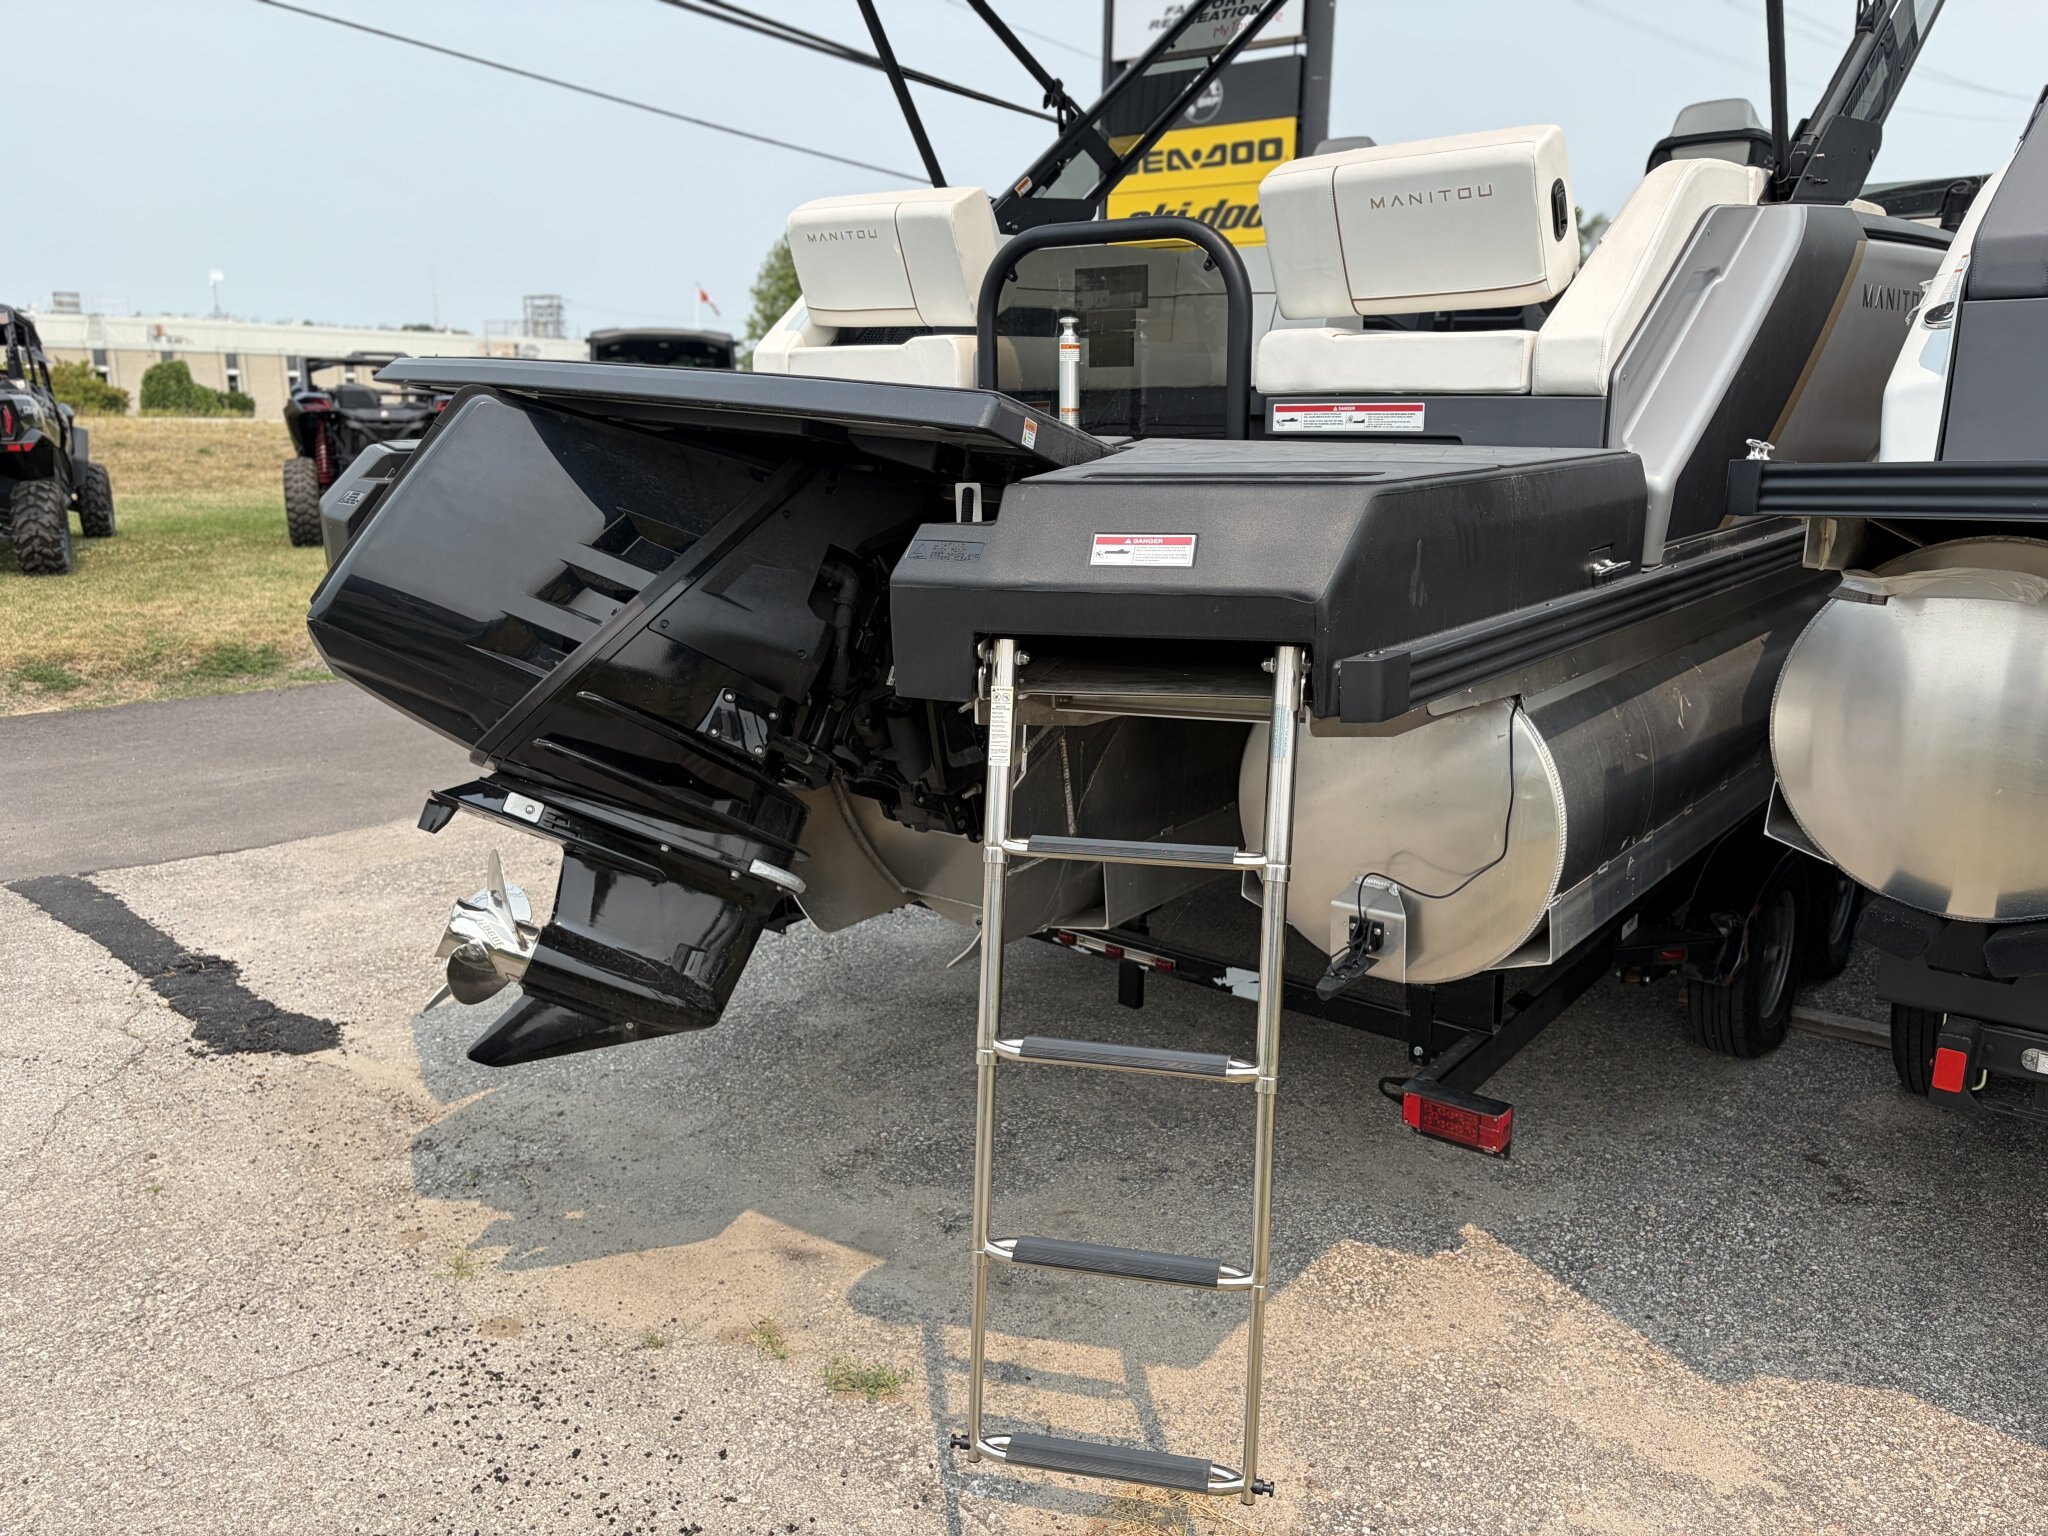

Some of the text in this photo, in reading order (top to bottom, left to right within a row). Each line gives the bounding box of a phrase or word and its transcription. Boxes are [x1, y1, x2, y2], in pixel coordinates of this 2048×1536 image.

[1370, 184, 1493, 210] MANITOU
[806, 229, 878, 243] MANITOU
[1862, 283, 1925, 313] MANITO
